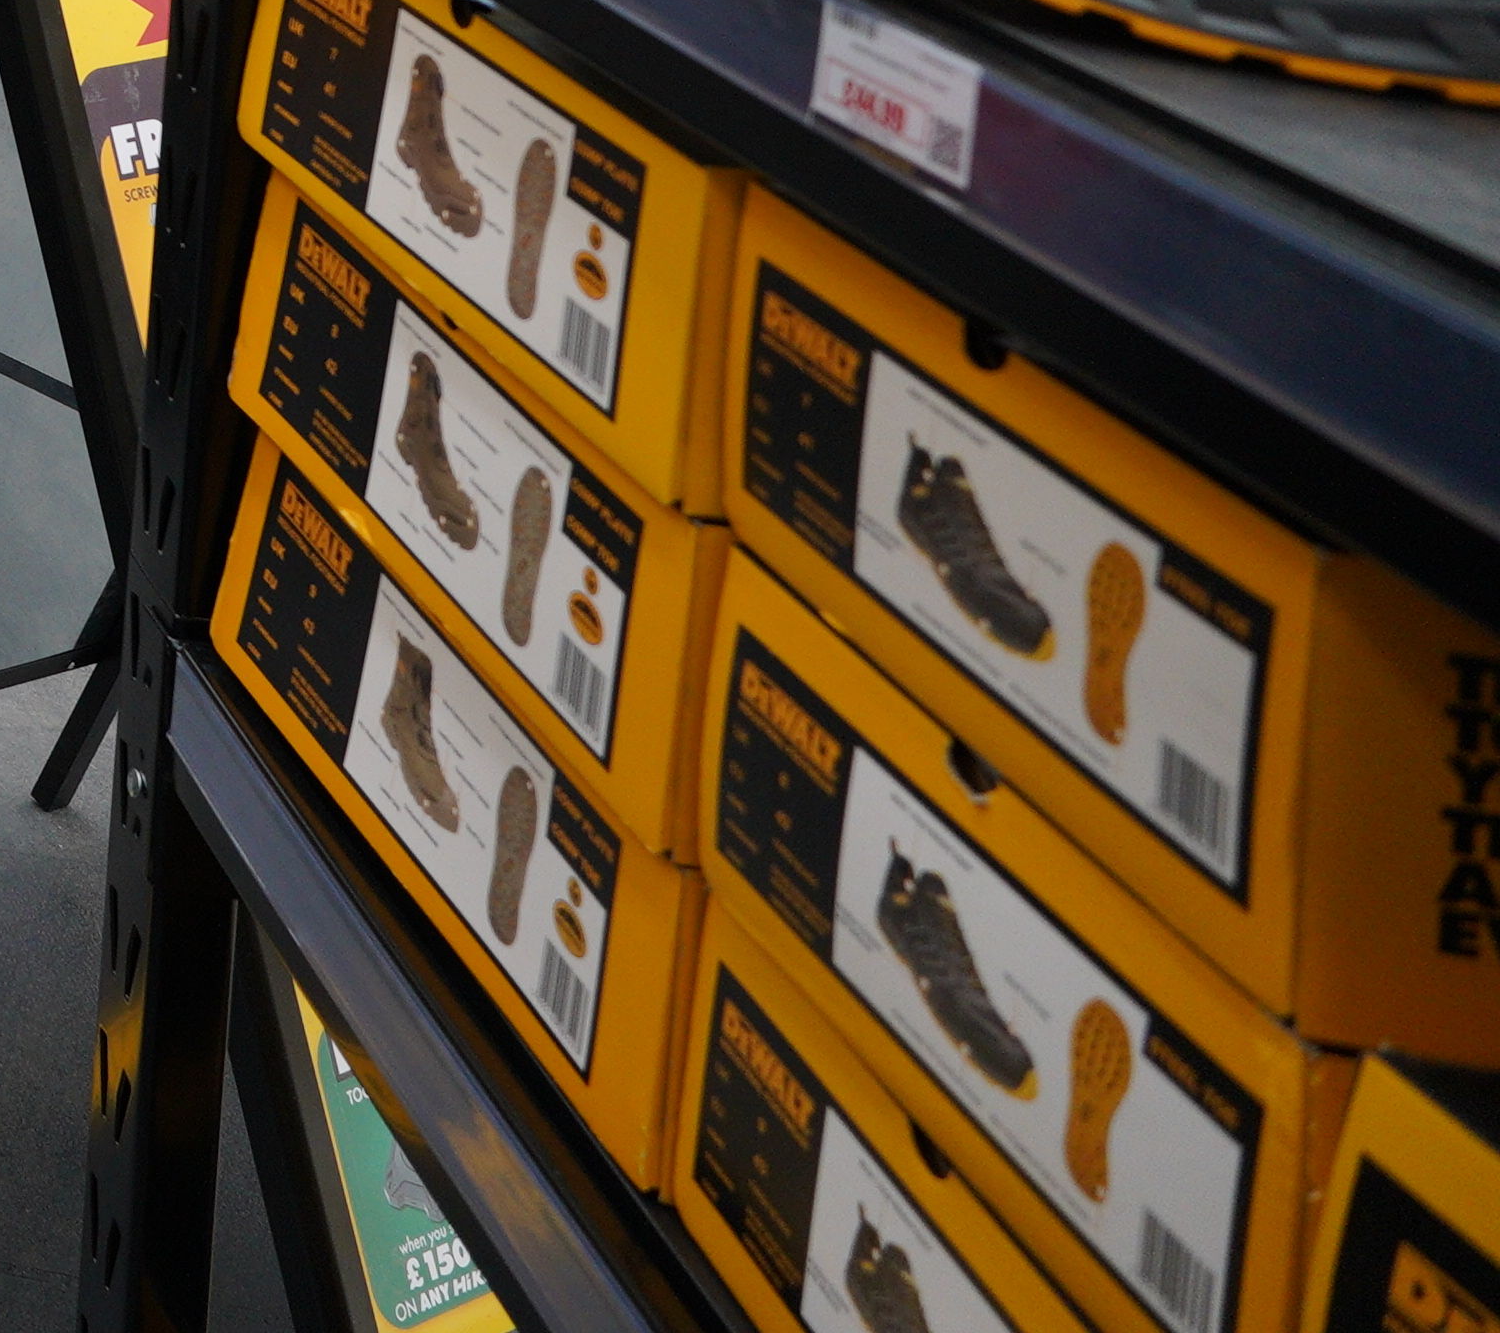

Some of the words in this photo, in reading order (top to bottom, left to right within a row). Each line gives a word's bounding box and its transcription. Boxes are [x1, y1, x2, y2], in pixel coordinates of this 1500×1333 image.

[399, 1236, 428, 1255] when
[427, 1227, 449, 1247] you
[406, 1237, 472, 1291] £150
[395, 1297, 419, 1322] ON
[420, 1288, 451, 1314] ANY
